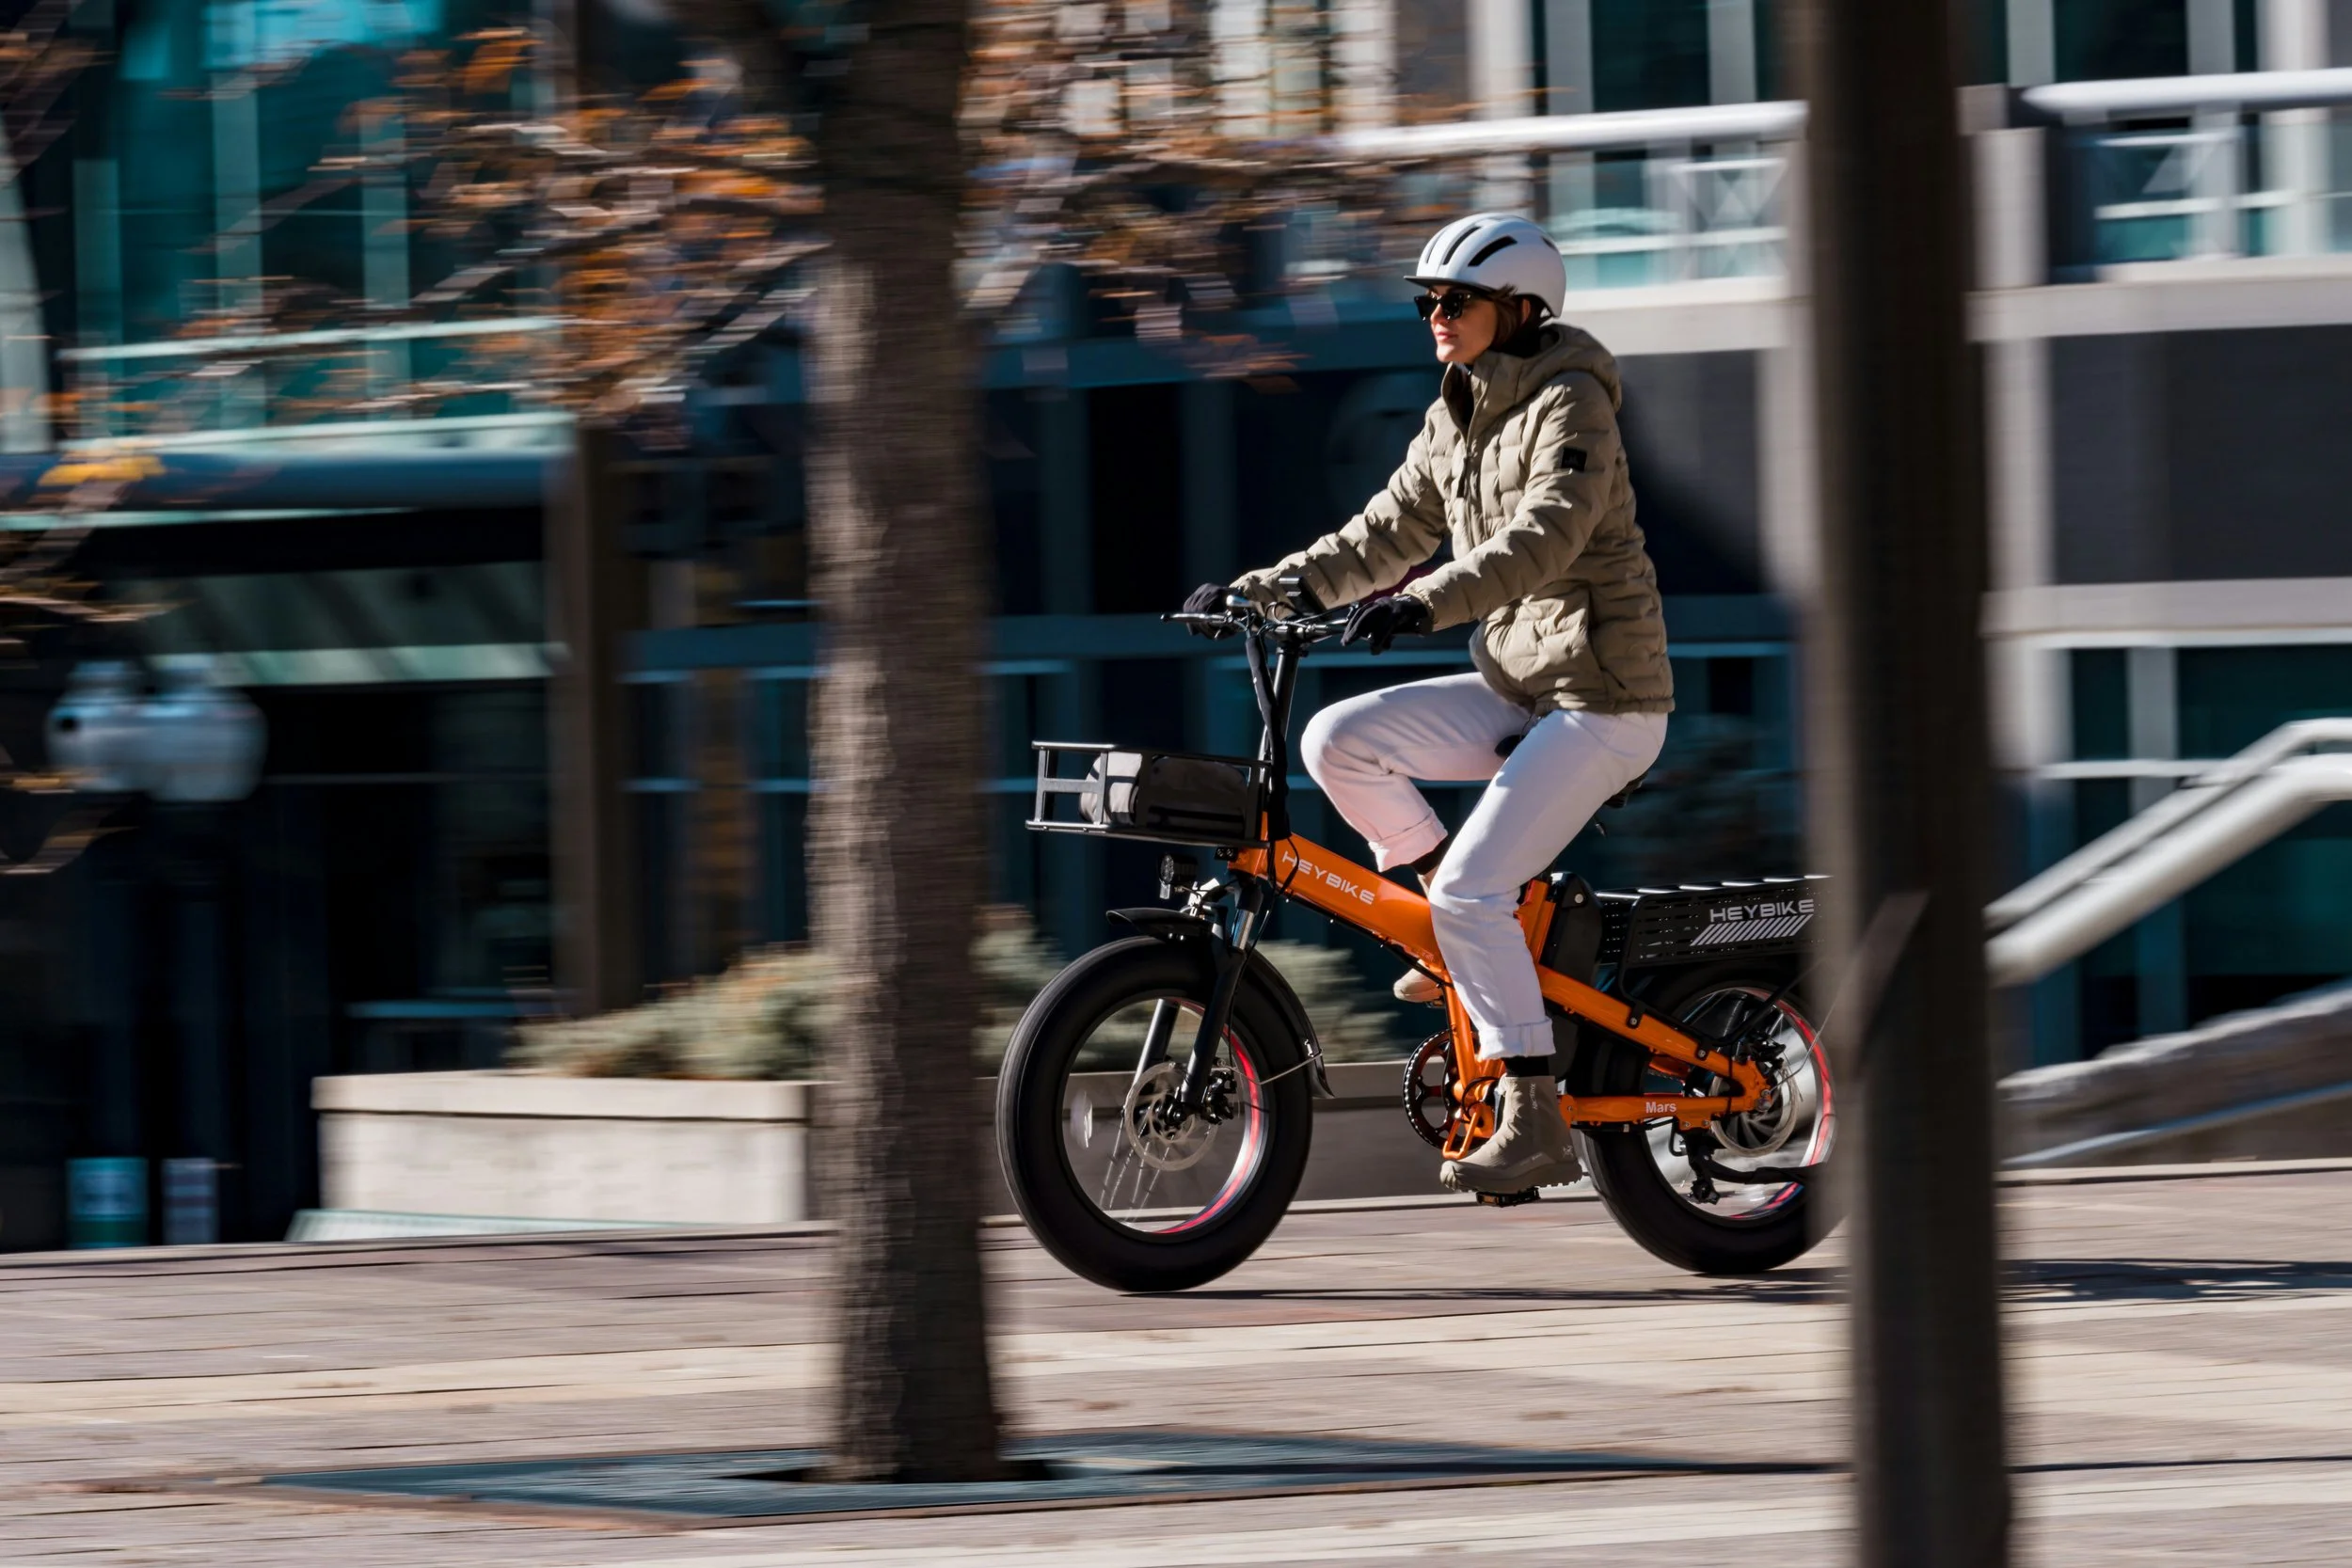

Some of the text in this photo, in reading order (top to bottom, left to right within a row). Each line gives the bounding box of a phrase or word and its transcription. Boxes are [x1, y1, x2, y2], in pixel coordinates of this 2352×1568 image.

[1281, 850, 1375, 905] HEYBIKE
[1709, 899, 1815, 923] HEYBIKE
[1645, 1101, 1677, 1114] Mars
